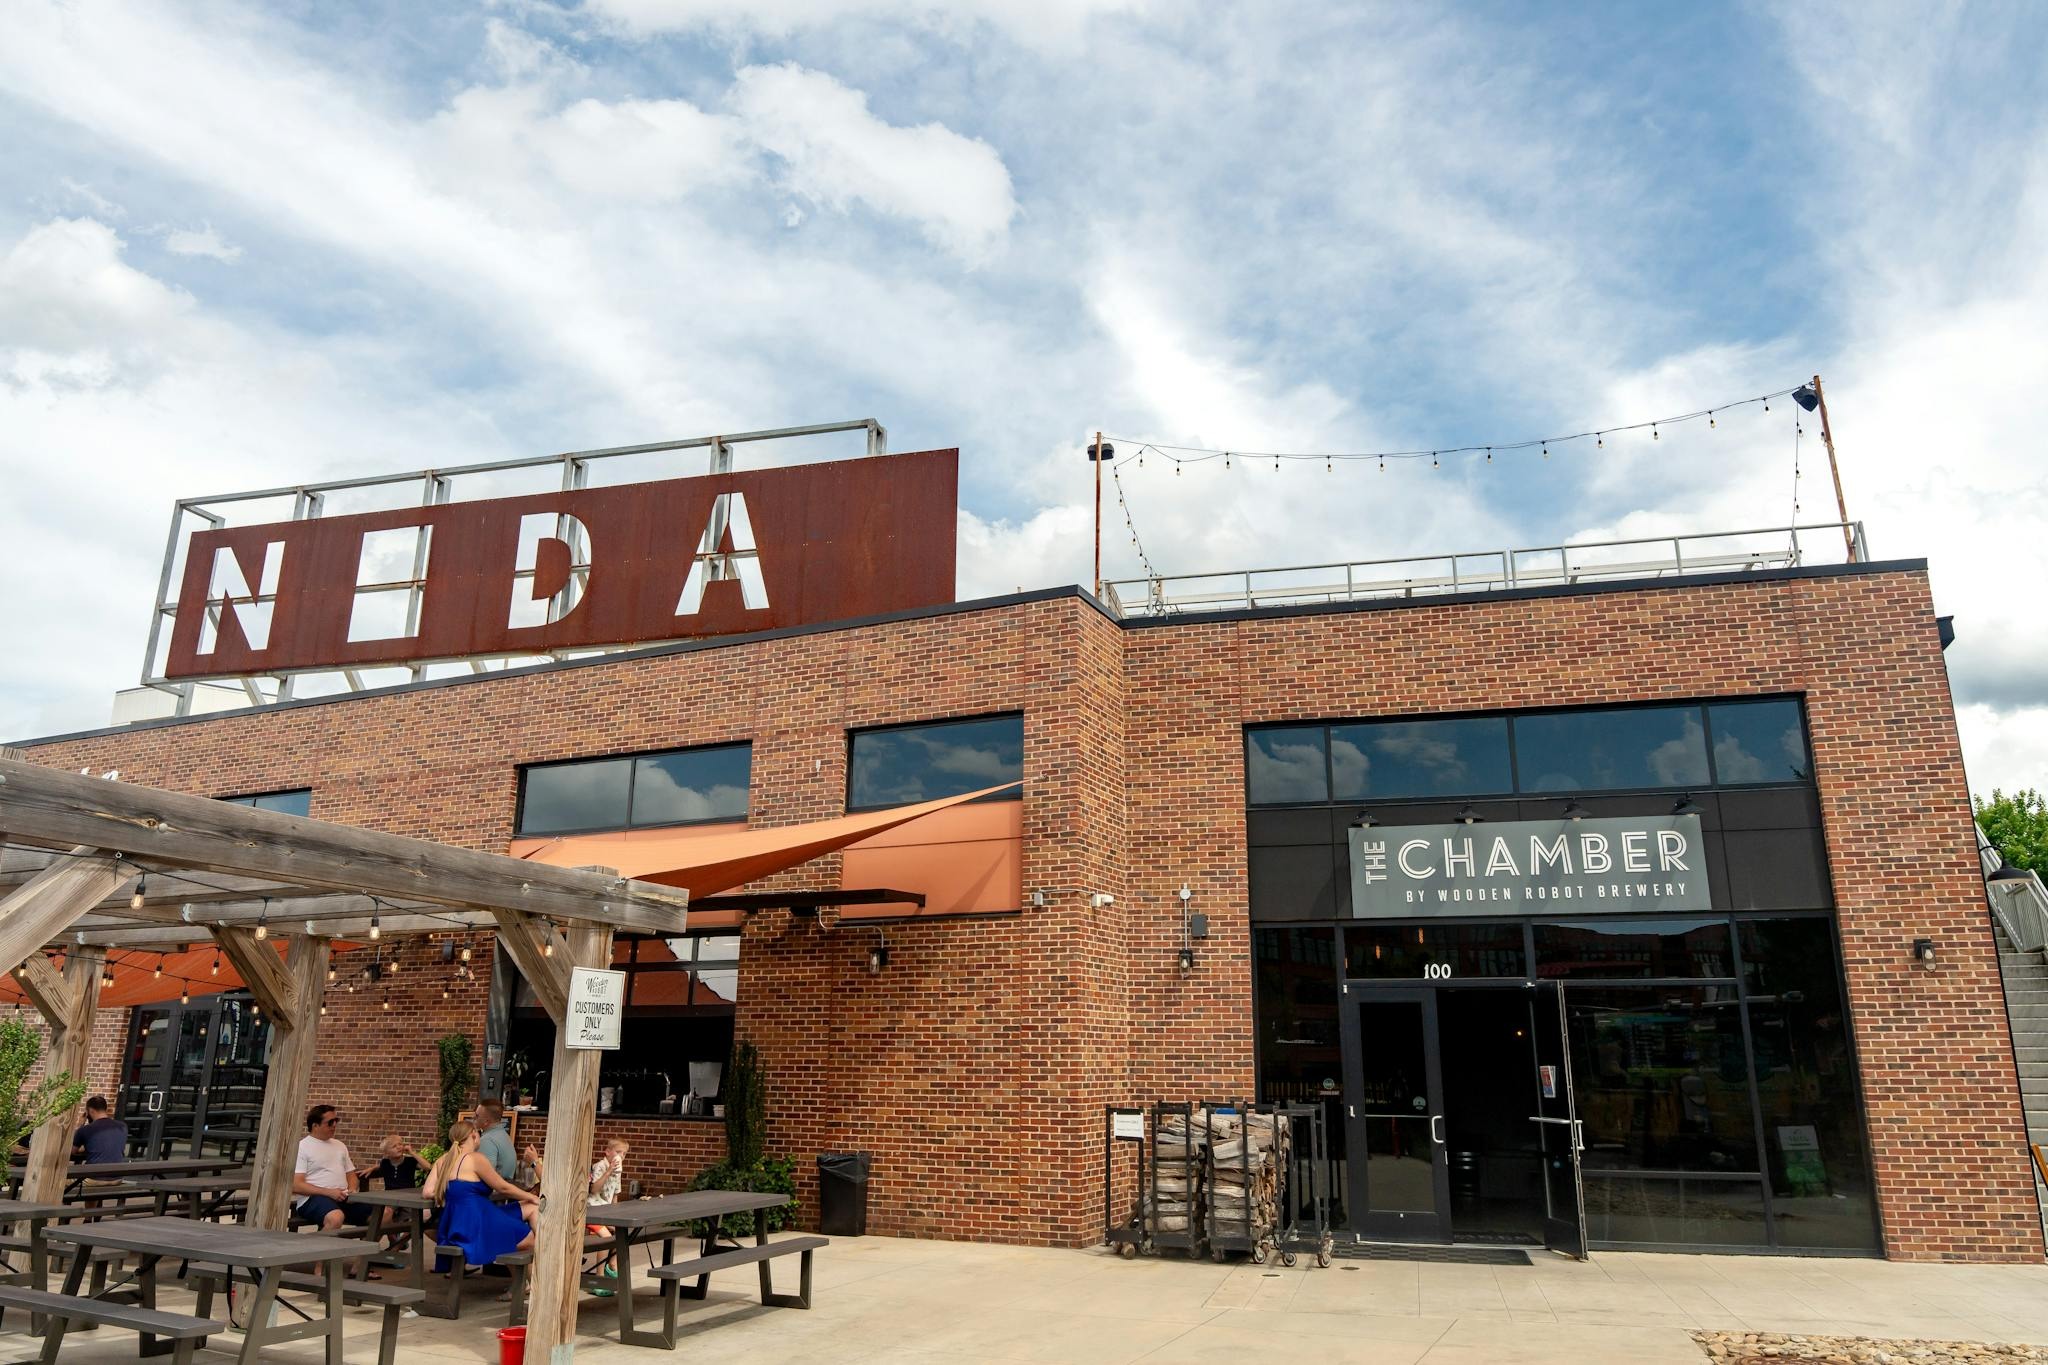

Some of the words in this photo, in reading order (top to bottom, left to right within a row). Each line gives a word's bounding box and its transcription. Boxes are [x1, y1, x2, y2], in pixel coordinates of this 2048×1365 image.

[1364, 840, 1387, 884] THE
[1398, 830, 1690, 879] CHAMBER
[1406, 890, 1425, 903] BY
[1438, 887, 1511, 902] WOODEN
[1525, 885, 1584, 900] ROBOT
[1598, 883, 1687, 898] BREWERY
[1424, 963, 1451, 979] 100
[575, 1001, 614, 1015] CUSTOMERS
[584, 1016, 601, 1029] ONLY
[580, 1029, 605, 1041] Please
